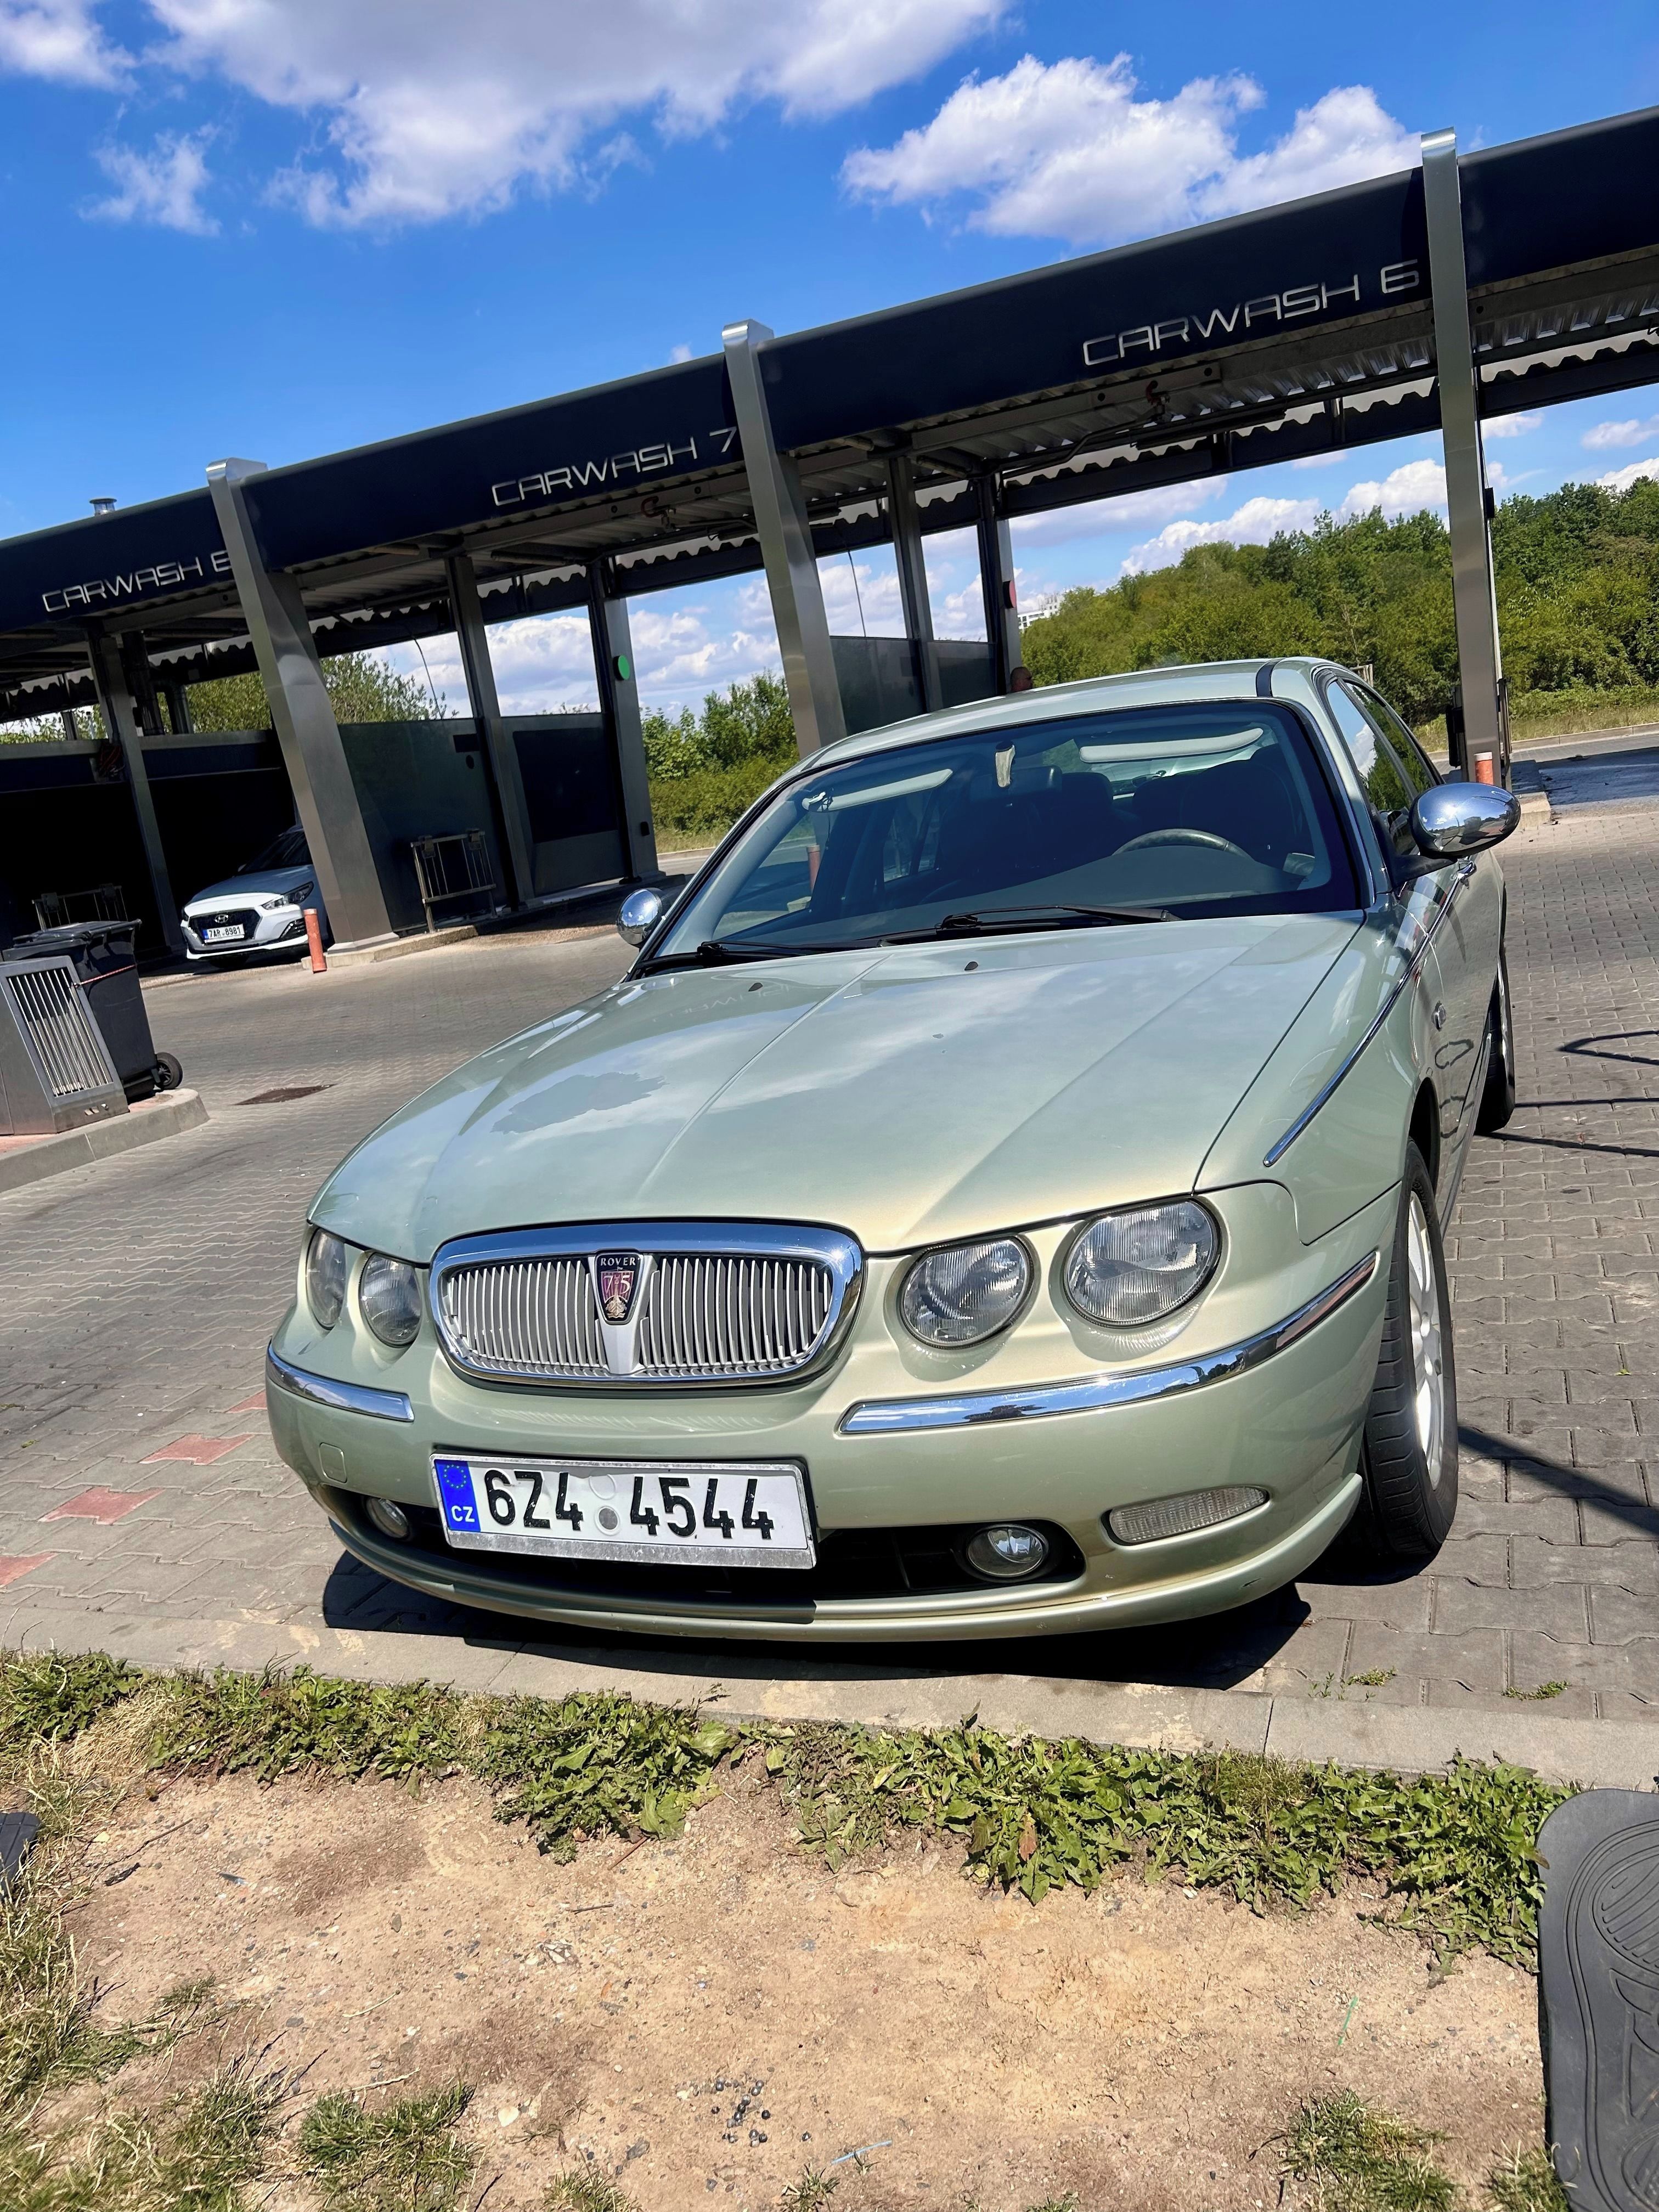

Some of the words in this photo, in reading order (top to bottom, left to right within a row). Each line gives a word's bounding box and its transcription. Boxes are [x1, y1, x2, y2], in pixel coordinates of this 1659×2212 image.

[1082, 274, 1361, 366] CARWASH
[1380, 258, 1420, 295] 6
[492, 436, 698, 506] CARWASH
[709, 426, 737, 453] 7
[42, 556, 204, 612] CARWASH
[208, 929, 222, 938] 7AR
[225, 926, 241, 936] 8981
[600, 1257, 636, 1266] ROVER
[603, 1274, 631, 1294] 75
[451, 1505, 476, 1523] CZ
[484, 1469, 583, 1531] 6Z4
[629, 1476, 774, 1539] 4544
